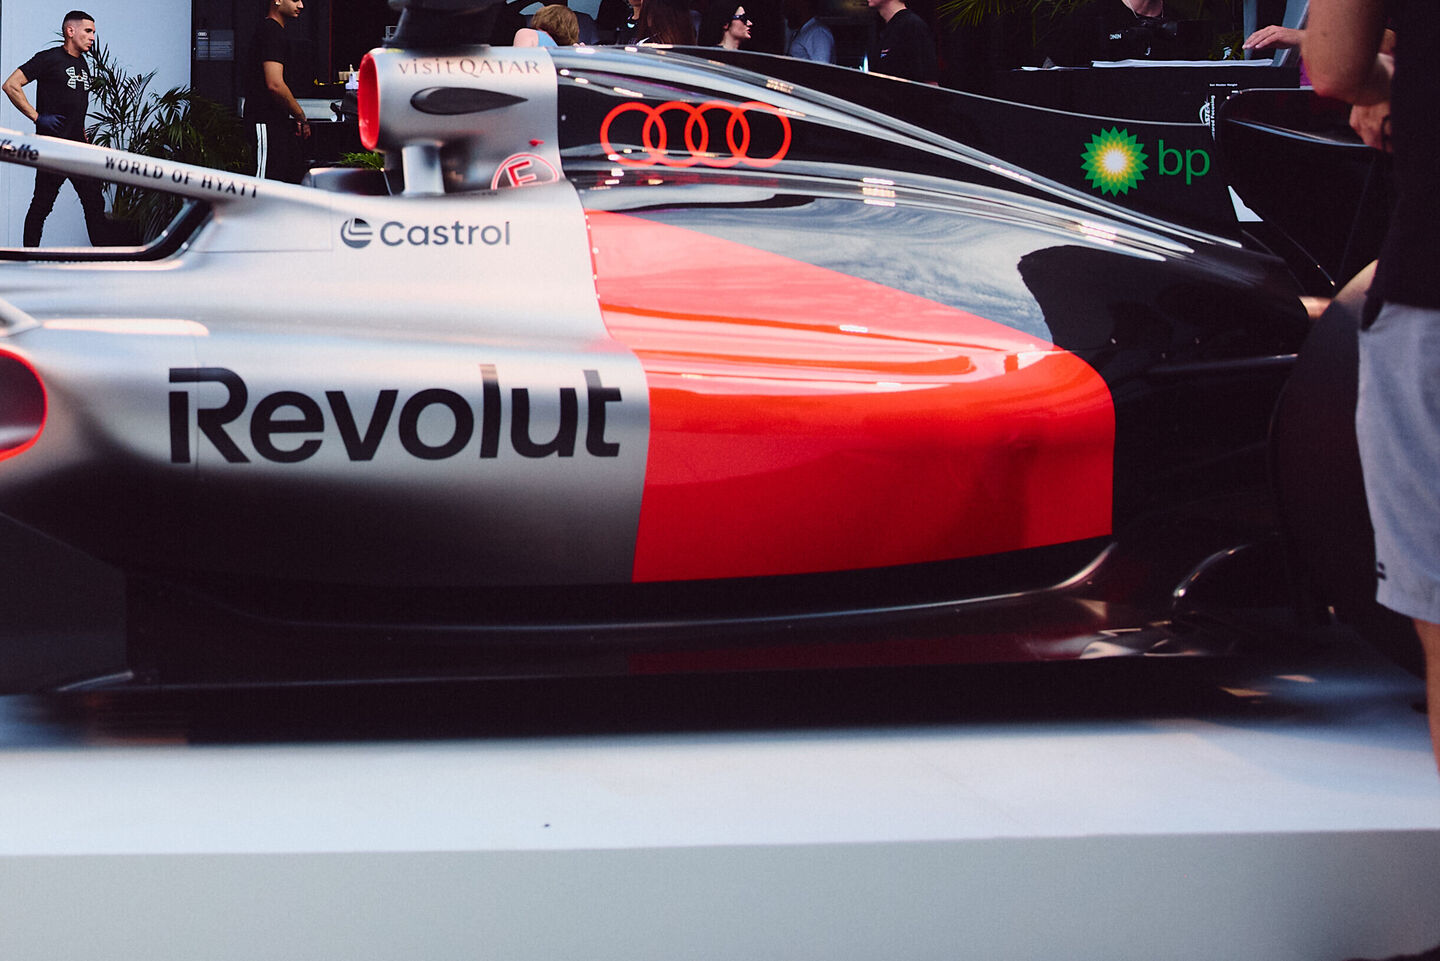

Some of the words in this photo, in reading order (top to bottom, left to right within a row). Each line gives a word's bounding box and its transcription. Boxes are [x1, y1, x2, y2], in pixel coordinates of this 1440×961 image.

[105, 156, 164, 180] WORLD
[172, 169, 193, 185] OF
[201, 175, 260, 199] HYATT
[1158, 139, 1210, 185] bp
[379, 221, 511, 247] Castrol
[168, 363, 623, 465] Revolut
